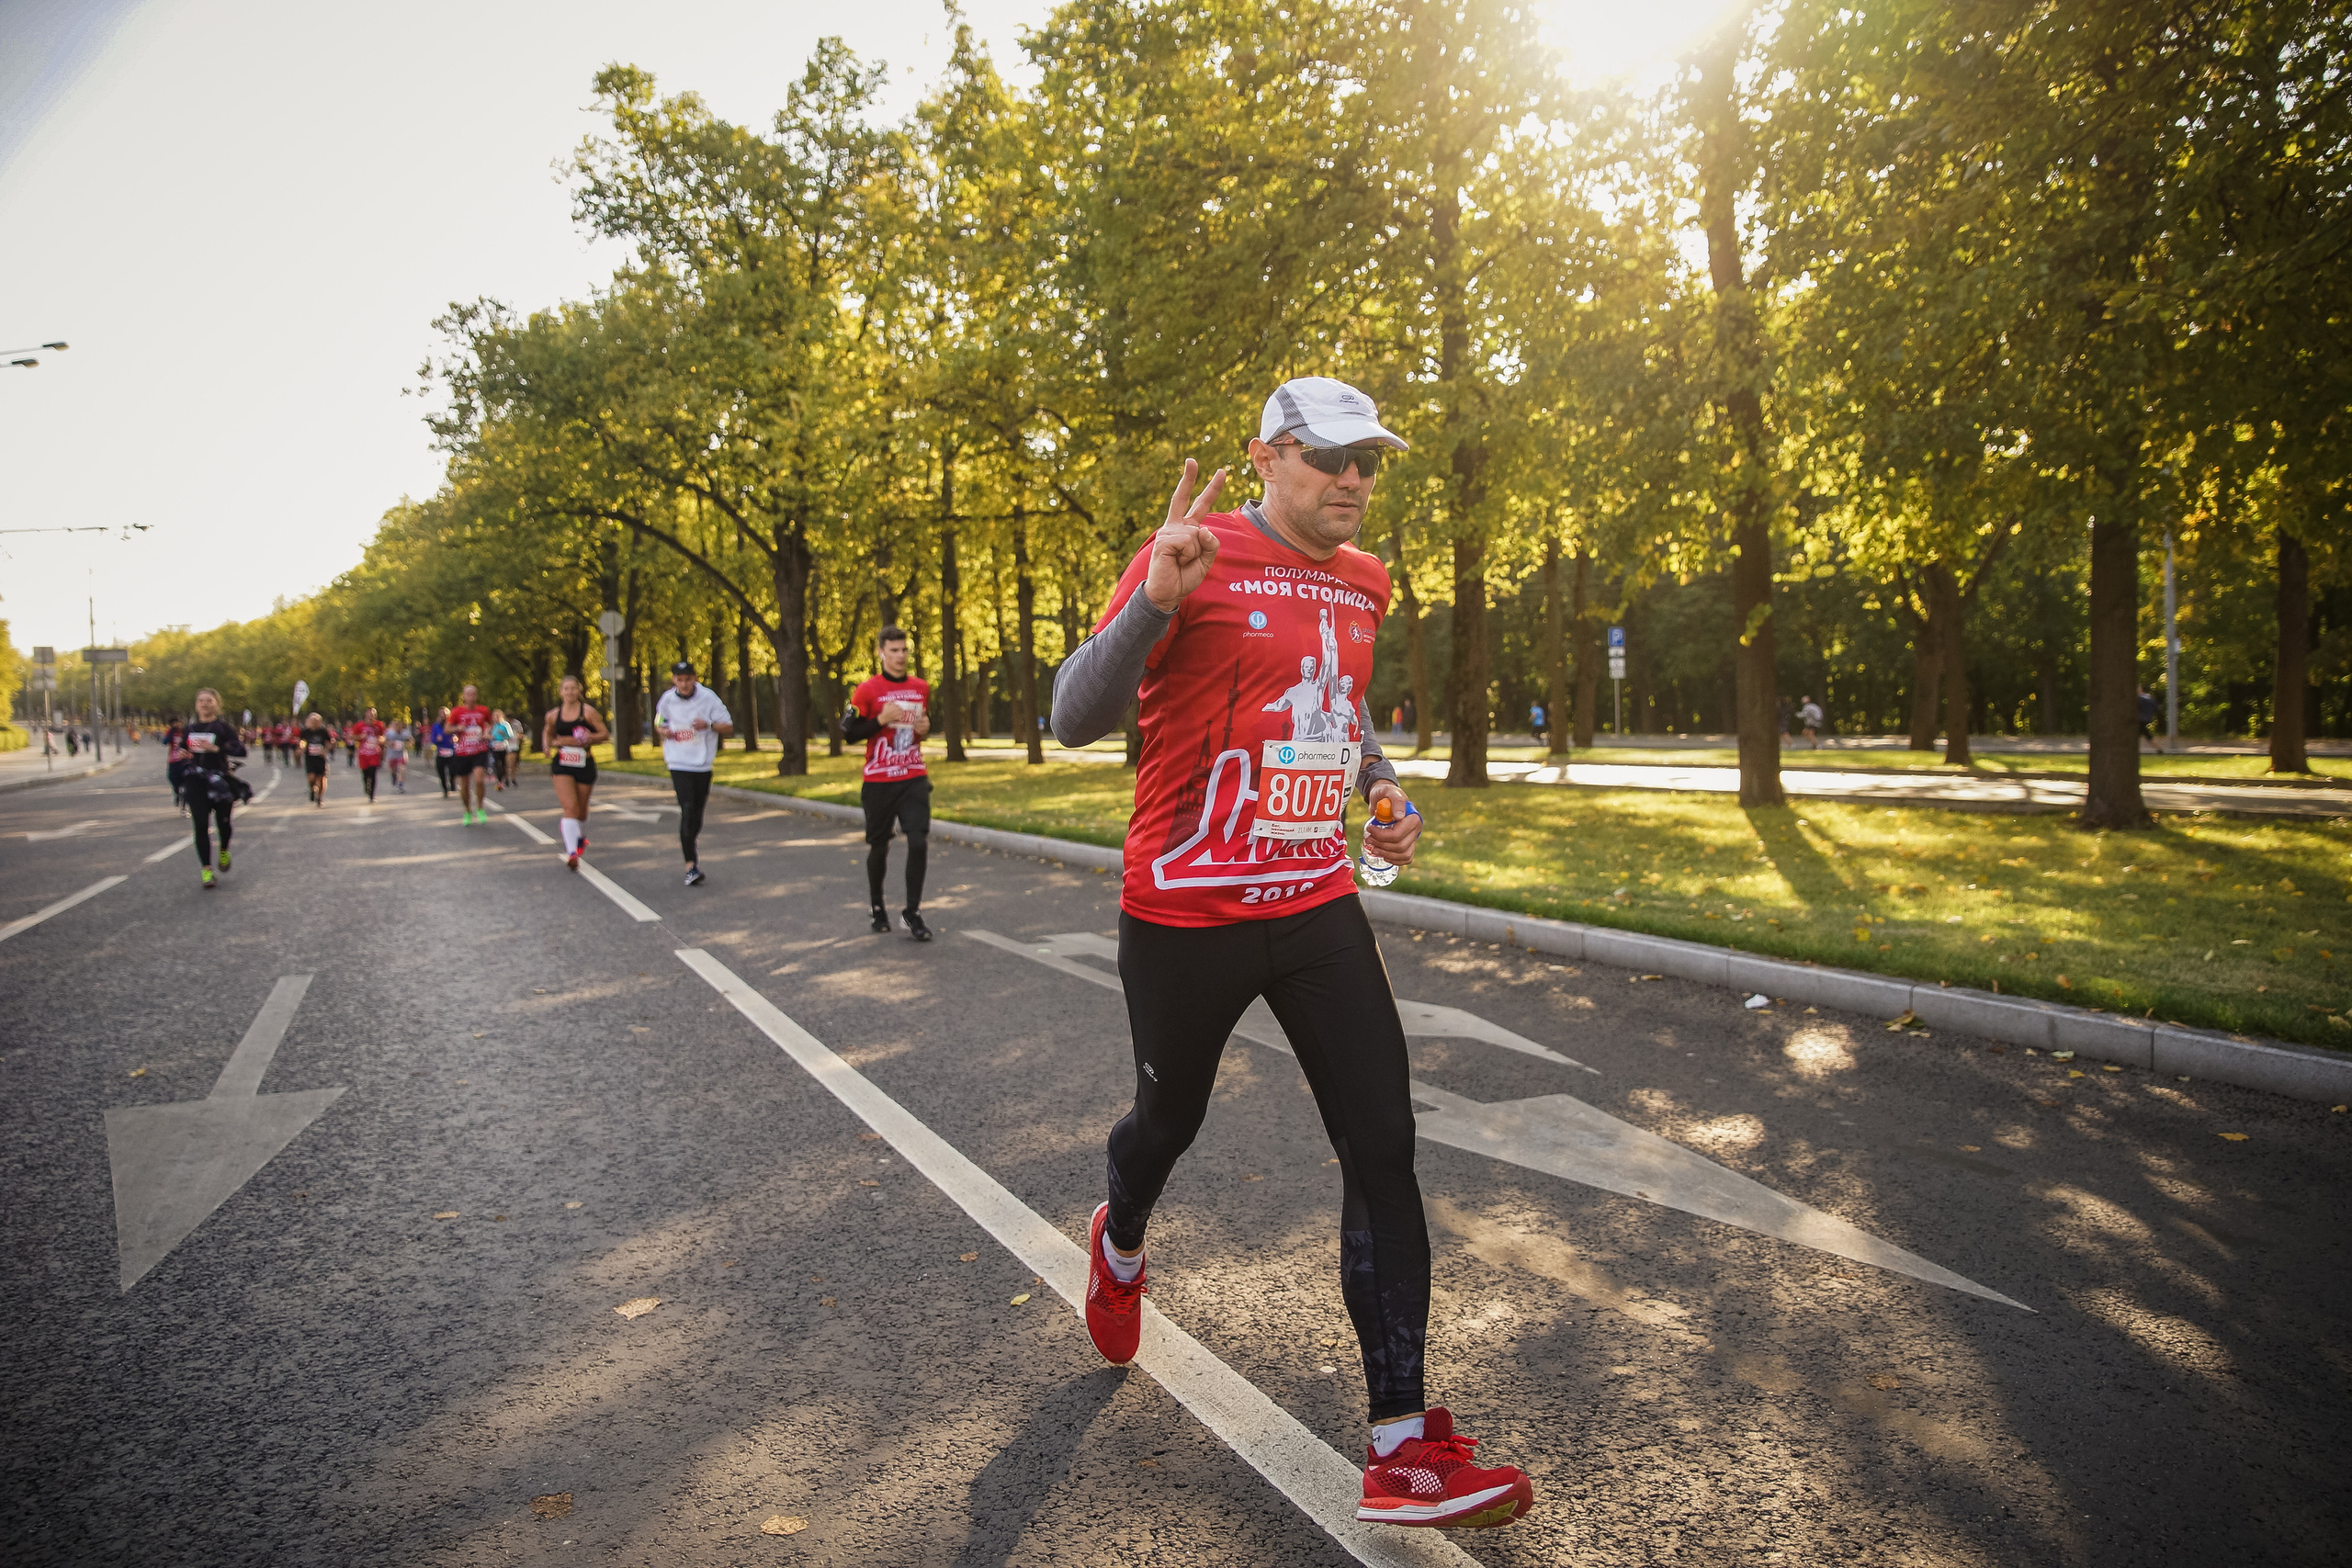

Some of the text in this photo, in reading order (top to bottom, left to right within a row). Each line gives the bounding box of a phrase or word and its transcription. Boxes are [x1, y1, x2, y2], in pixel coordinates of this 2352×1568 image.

[1228, 580, 1377, 612] «МОЯ СТОЛИЦА
[1297, 748, 1351, 765] pharmeco D
[1267, 773, 1342, 818] 8075
